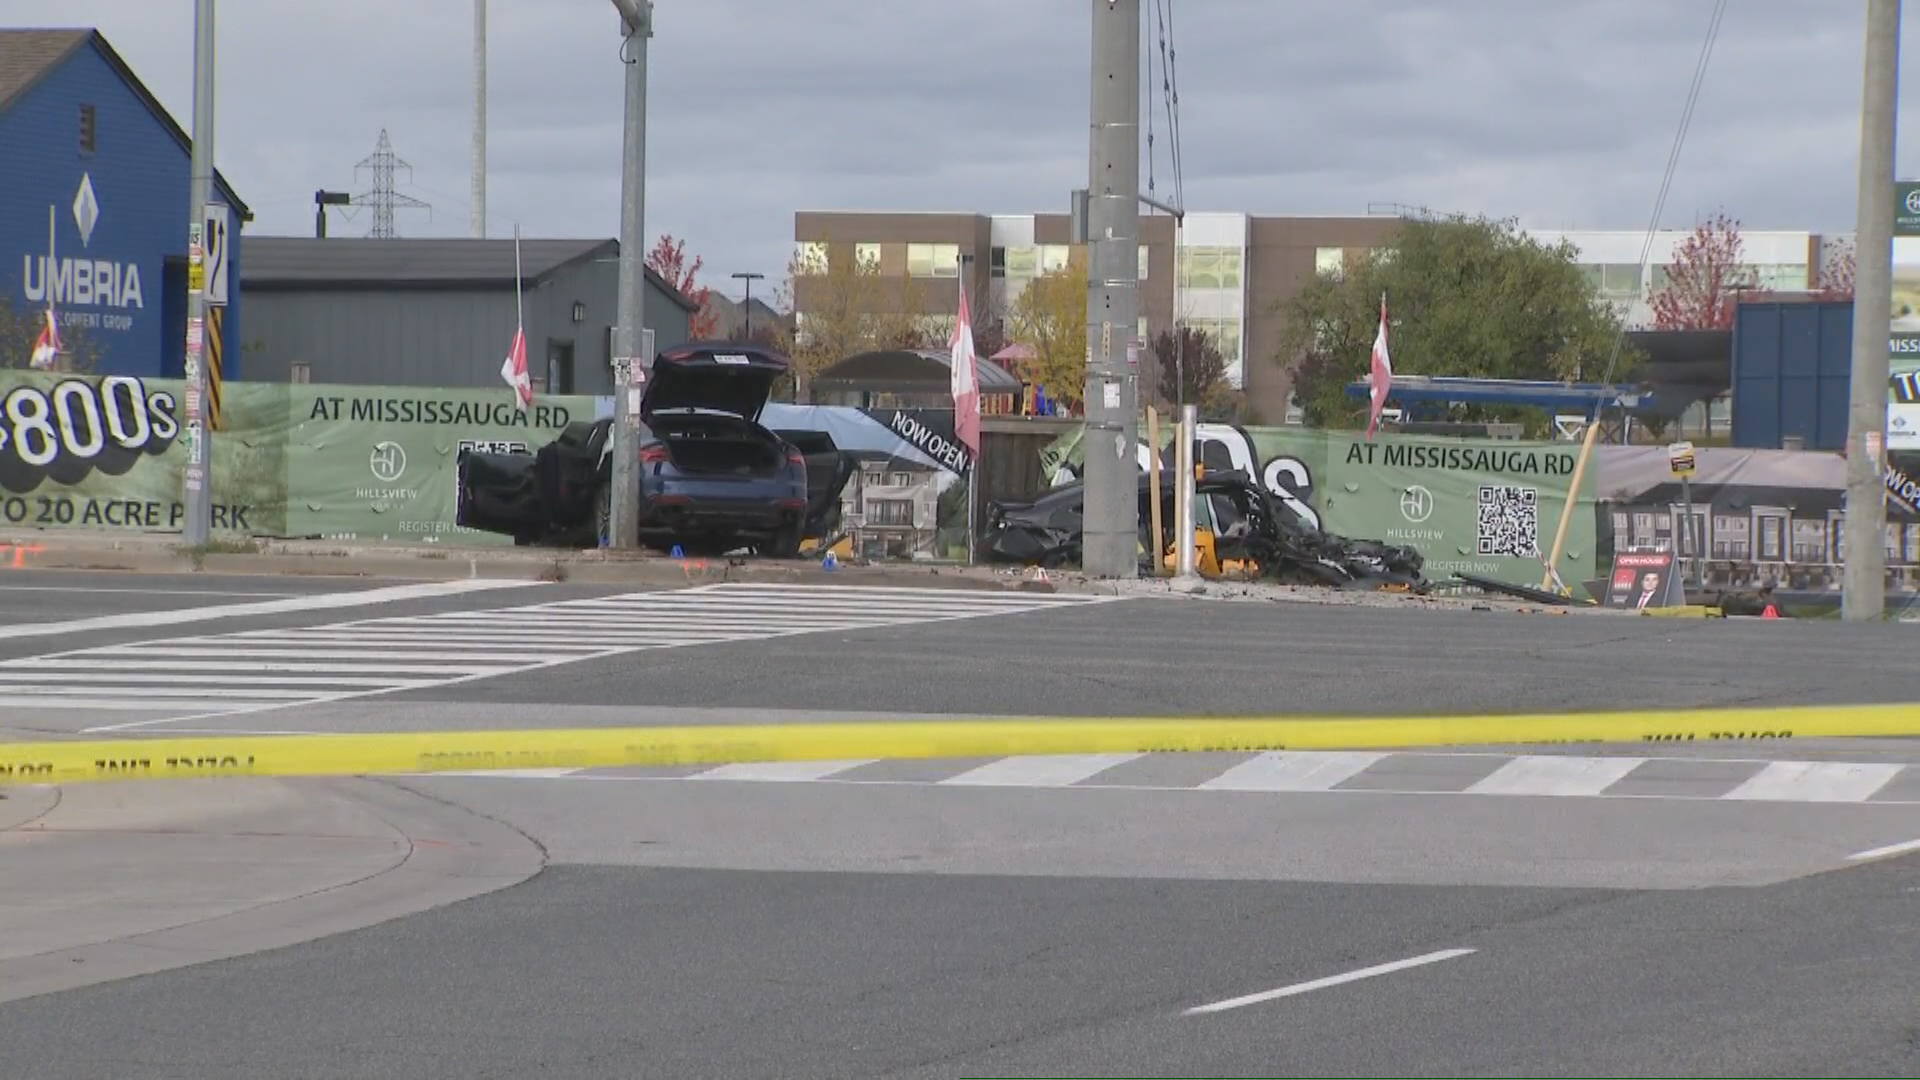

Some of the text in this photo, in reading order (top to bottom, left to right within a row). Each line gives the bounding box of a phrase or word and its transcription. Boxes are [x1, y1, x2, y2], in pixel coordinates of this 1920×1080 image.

[24, 255, 143, 308] UMBRIA
[103, 314, 133, 331] GROUP
[310, 397, 569, 428] AT MISSISSAUGA RD
[890, 410, 967, 472] NOW OPEN
[1346, 443, 1574, 475] AT MISSISSAUGA RD
[356, 488, 417, 499] HILLSVIEW
[36, 500, 74, 524] 20
[82, 501, 161, 526] ACRE
[169, 503, 250, 530] PRK
[399, 520, 450, 533] REGISTER
[1387, 528, 1444, 540] HILLSVIEW
[1425, 559, 1500, 573] REGISTER NOW
[1619, 556, 1664, 565] OPEN HOUSE
